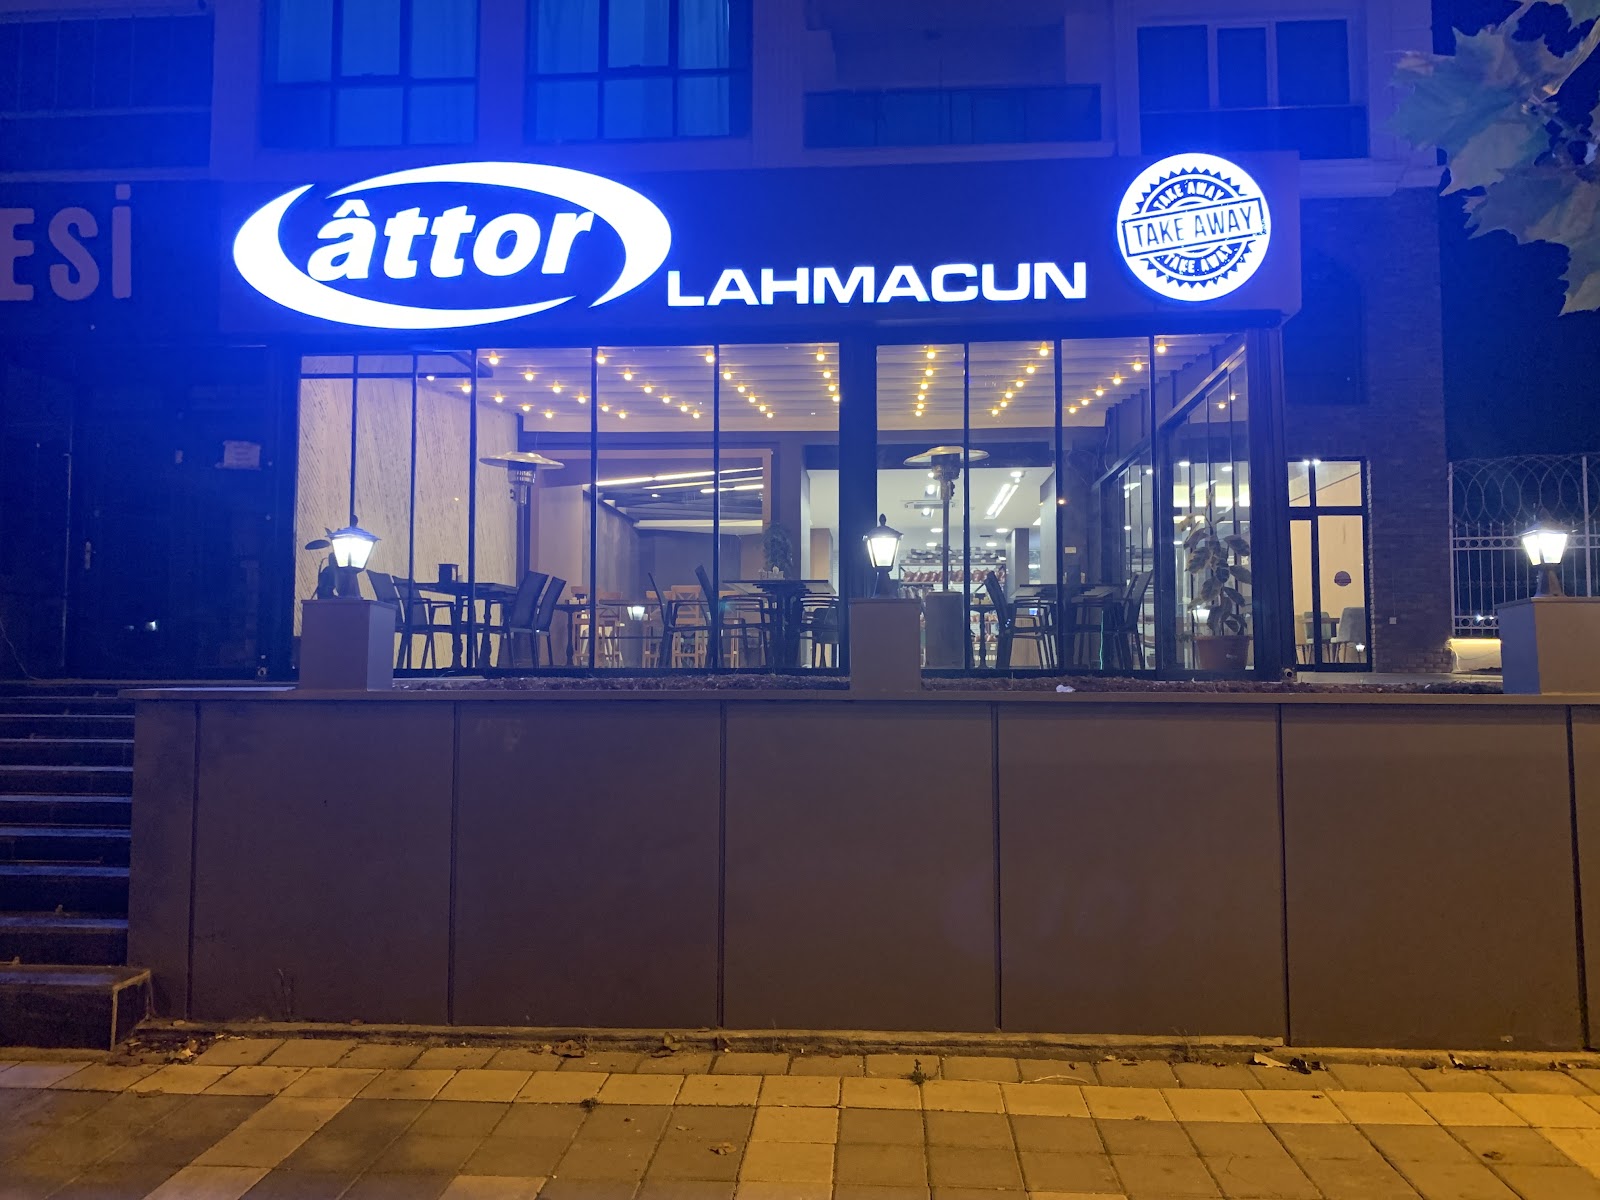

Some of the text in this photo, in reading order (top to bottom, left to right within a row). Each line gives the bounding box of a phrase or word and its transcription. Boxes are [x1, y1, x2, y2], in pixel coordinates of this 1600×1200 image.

[1153, 181, 1225, 209] TAKE AWAY
[0, 184, 132, 300] ESİ
[307, 199, 594, 281] âttor
[1132, 206, 1252, 248] TAKE AWAY
[667, 261, 1087, 306] LAHMACUN
